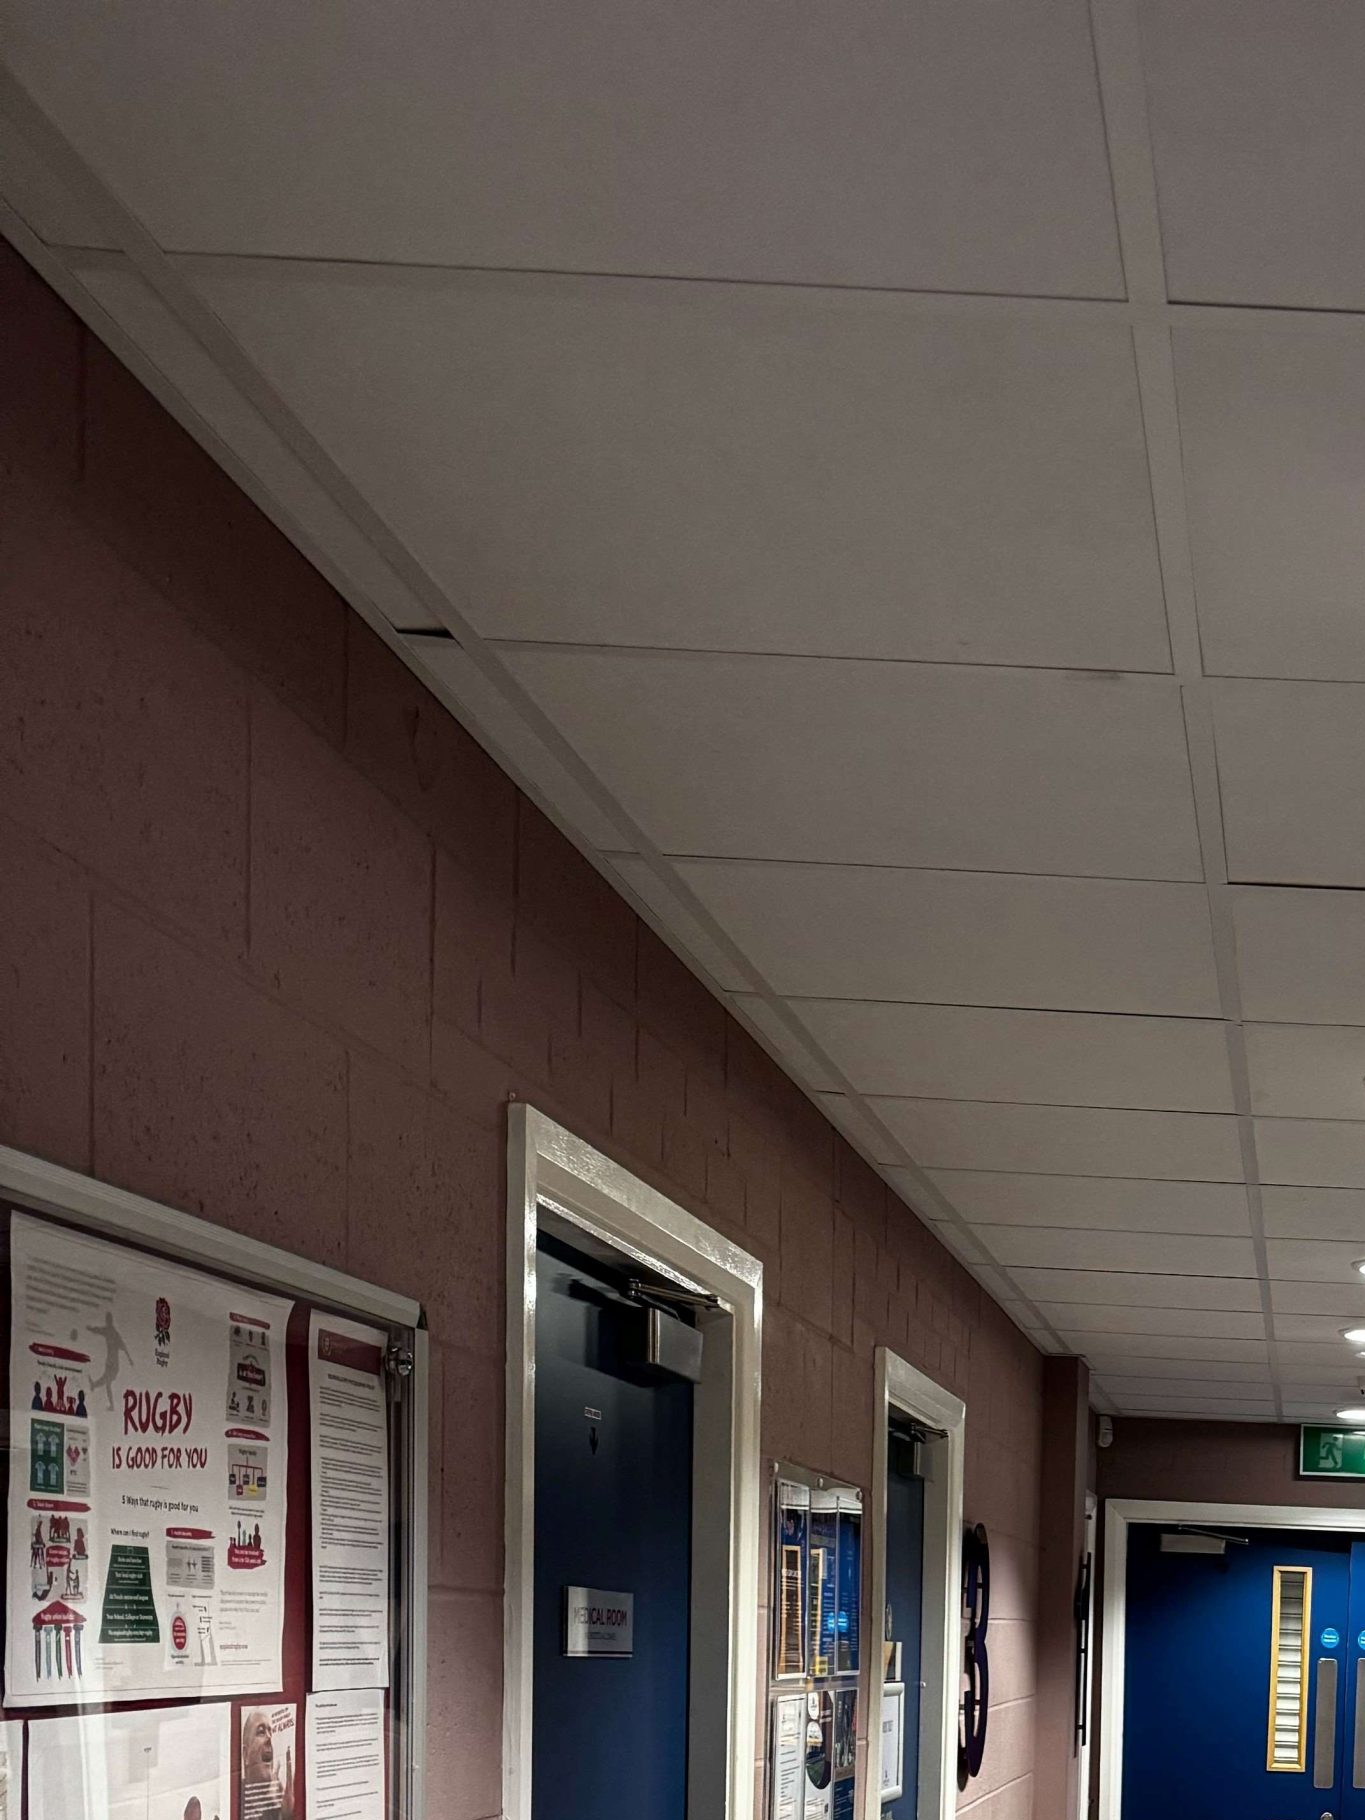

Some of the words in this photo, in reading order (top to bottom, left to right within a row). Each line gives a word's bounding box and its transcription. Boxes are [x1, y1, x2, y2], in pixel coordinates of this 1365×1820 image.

[123, 1389, 193, 1436] RUGBY
[112, 1446, 122, 1469] IS
[126, 1446, 157, 1470] GOOD
[161, 1446, 182, 1469] FOR
[185, 1447, 207, 1469] YOU
[122, 1495, 126, 1504] 5
[140, 1497, 149, 1507] that
[150, 1498, 163, 1511] rugby
[168, 1500, 181, 1512] good
[189, 1503, 198, 1514] you
[573, 1606, 605, 1626] MEDICAL
[606, 1608, 628, 1627] ROOM
